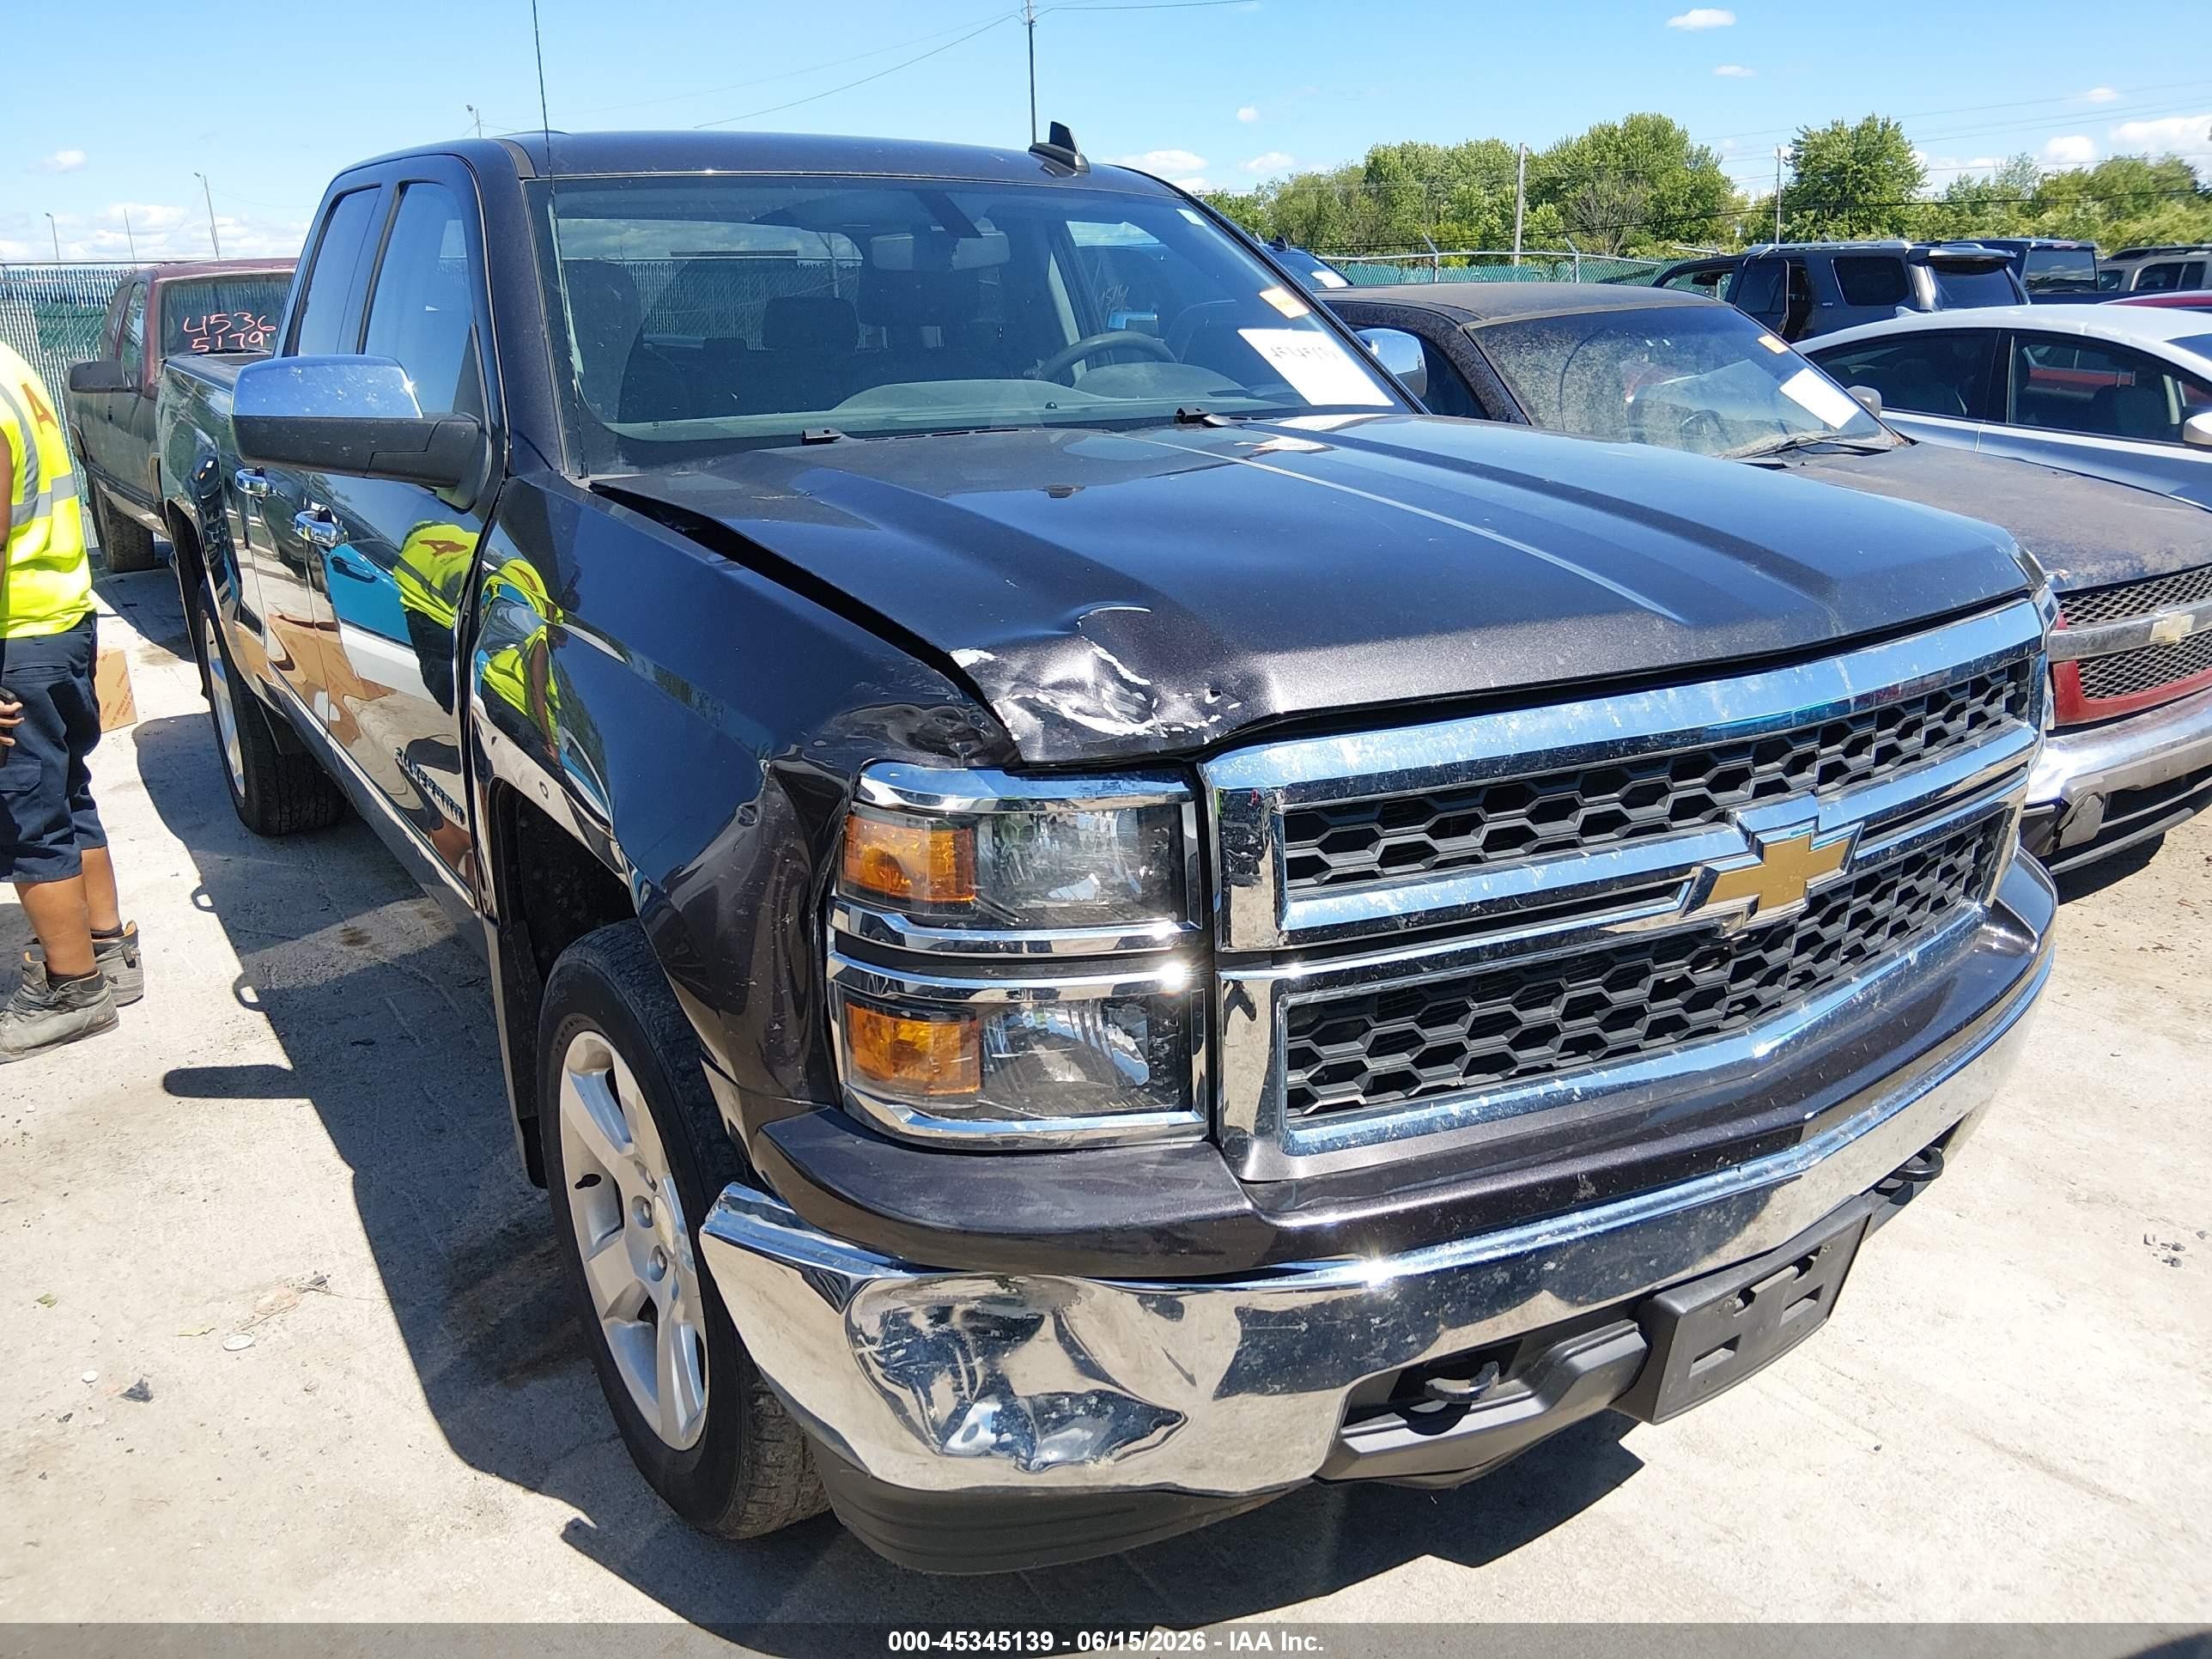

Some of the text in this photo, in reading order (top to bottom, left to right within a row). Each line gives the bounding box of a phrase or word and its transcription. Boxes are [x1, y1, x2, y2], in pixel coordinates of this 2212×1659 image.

[183, 312, 276, 336] 4536
[191, 331, 264, 351] 5179
[21, 383, 58, 434] A
